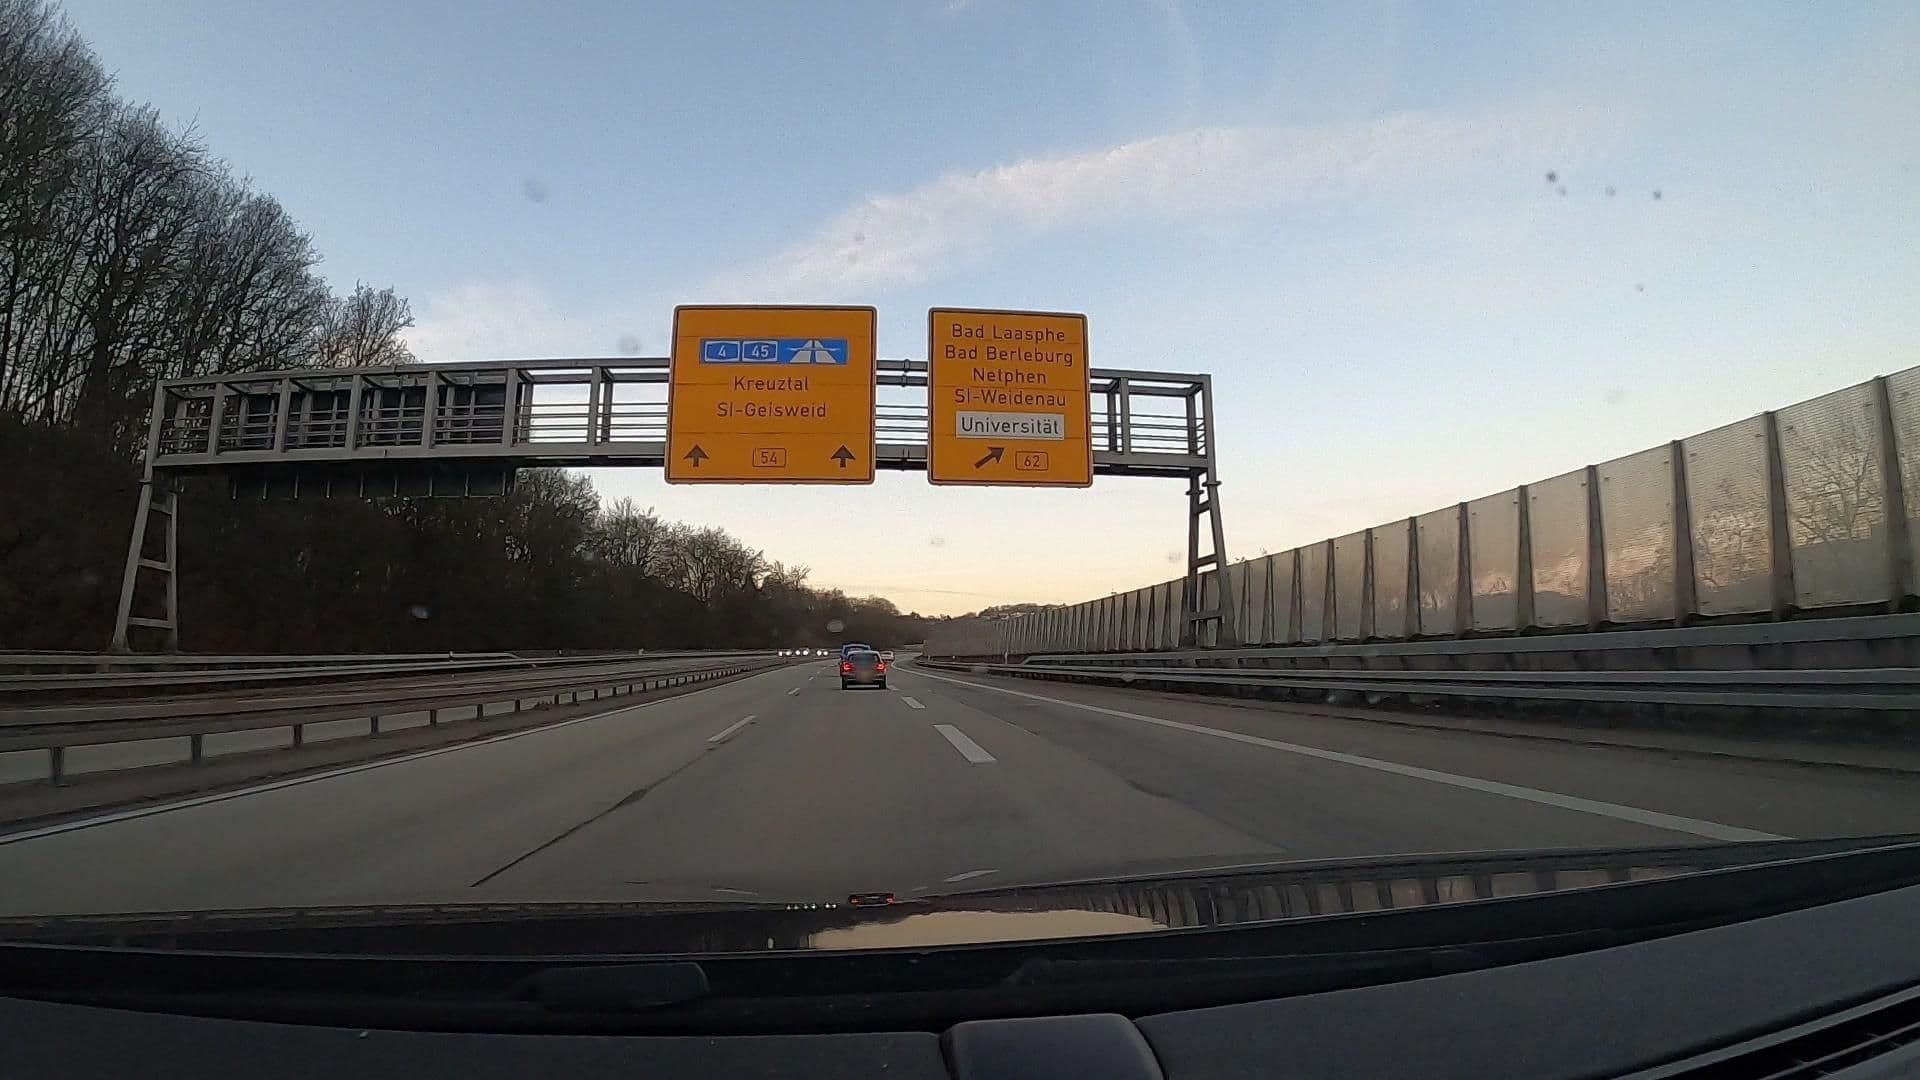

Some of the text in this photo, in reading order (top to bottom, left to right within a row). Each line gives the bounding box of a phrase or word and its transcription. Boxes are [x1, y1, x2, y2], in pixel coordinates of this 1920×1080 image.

[951, 323, 1065, 344] Bad Laasphe
[718, 344, 727, 358] 4
[751, 344, 770, 358] 45
[945, 345, 1073, 367] Bad Berleburg
[733, 375, 809, 392] Kreuztal
[973, 367, 1047, 386] Netphen
[954, 388, 1066, 407] SI-Weidenau
[716, 402, 827, 418] SI-Geisweid
[961, 416, 1060, 434] Universität
[760, 451, 778, 465] 54
[1023, 455, 1041, 468] 62
